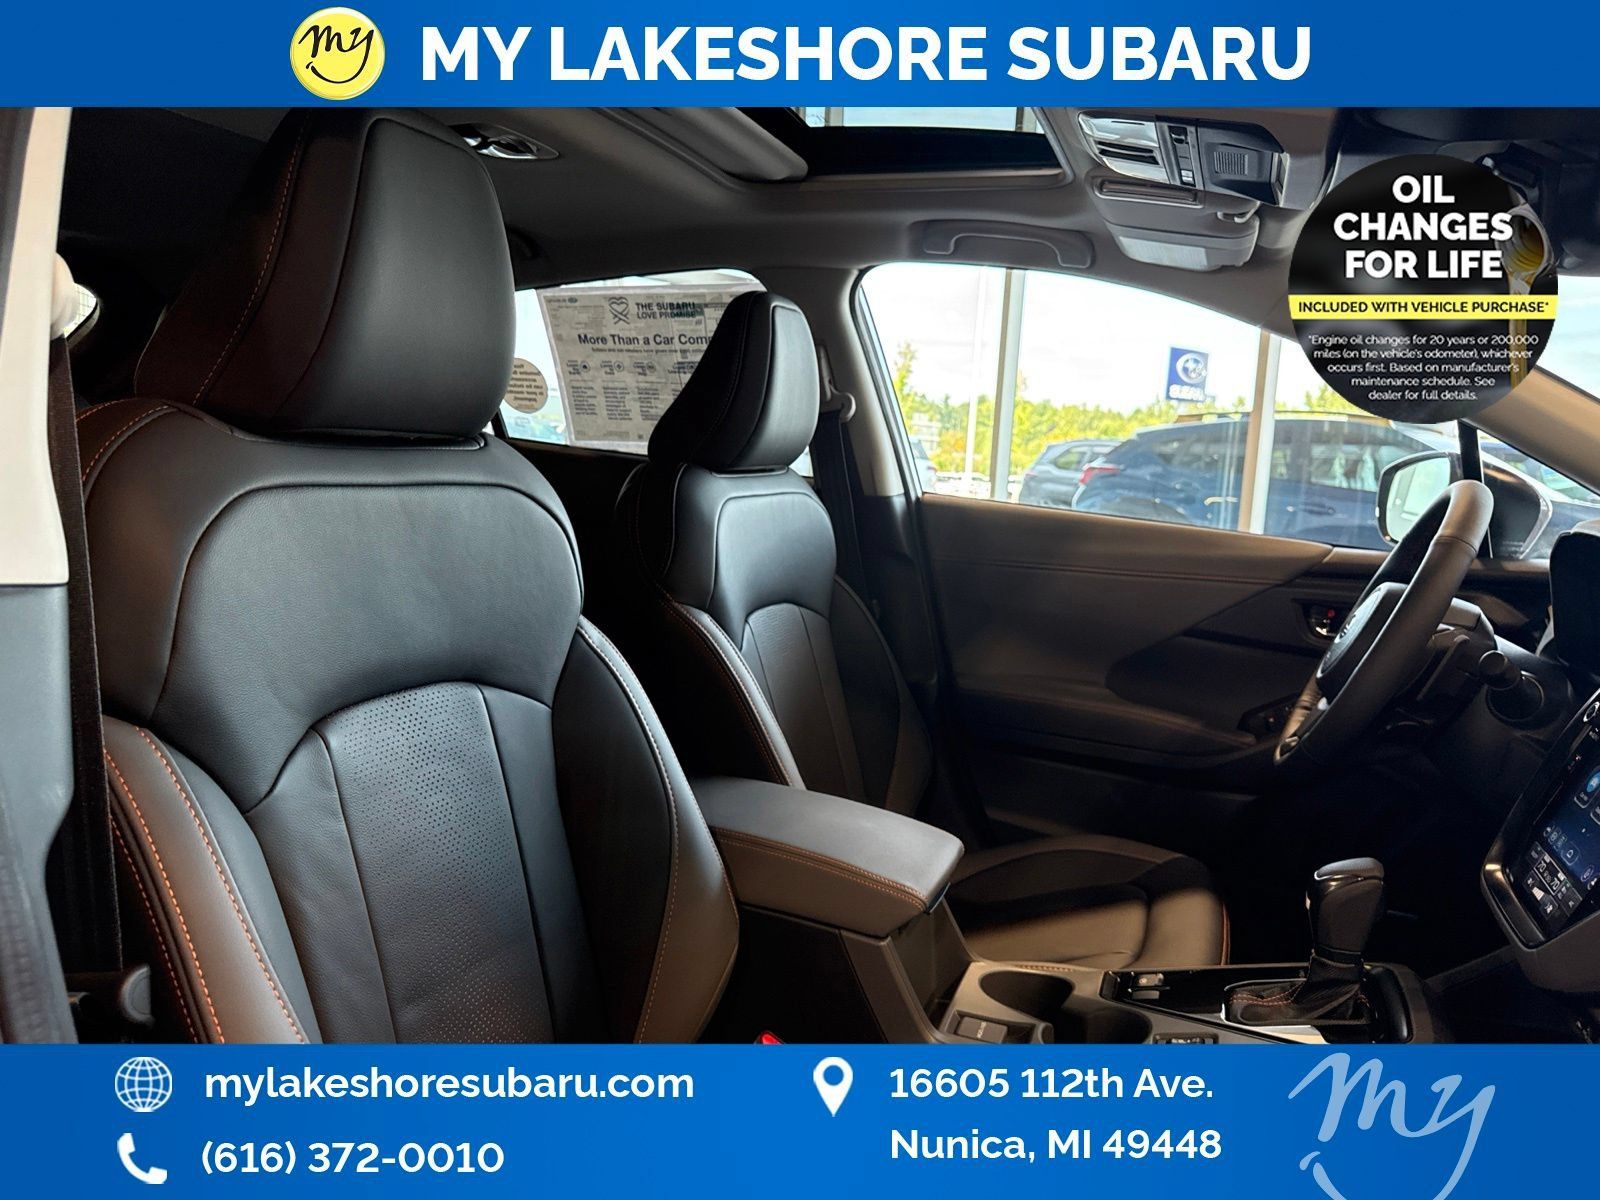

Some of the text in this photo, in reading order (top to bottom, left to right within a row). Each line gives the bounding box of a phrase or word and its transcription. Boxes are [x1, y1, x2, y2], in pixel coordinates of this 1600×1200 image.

[635, 302, 696, 311] THE SUBARU
[636, 311, 657, 320] LOVE
[577, 333, 608, 346] More
[609, 333, 640, 346] Than
[642, 336, 651, 346] a
[653, 333, 675, 346] Car
